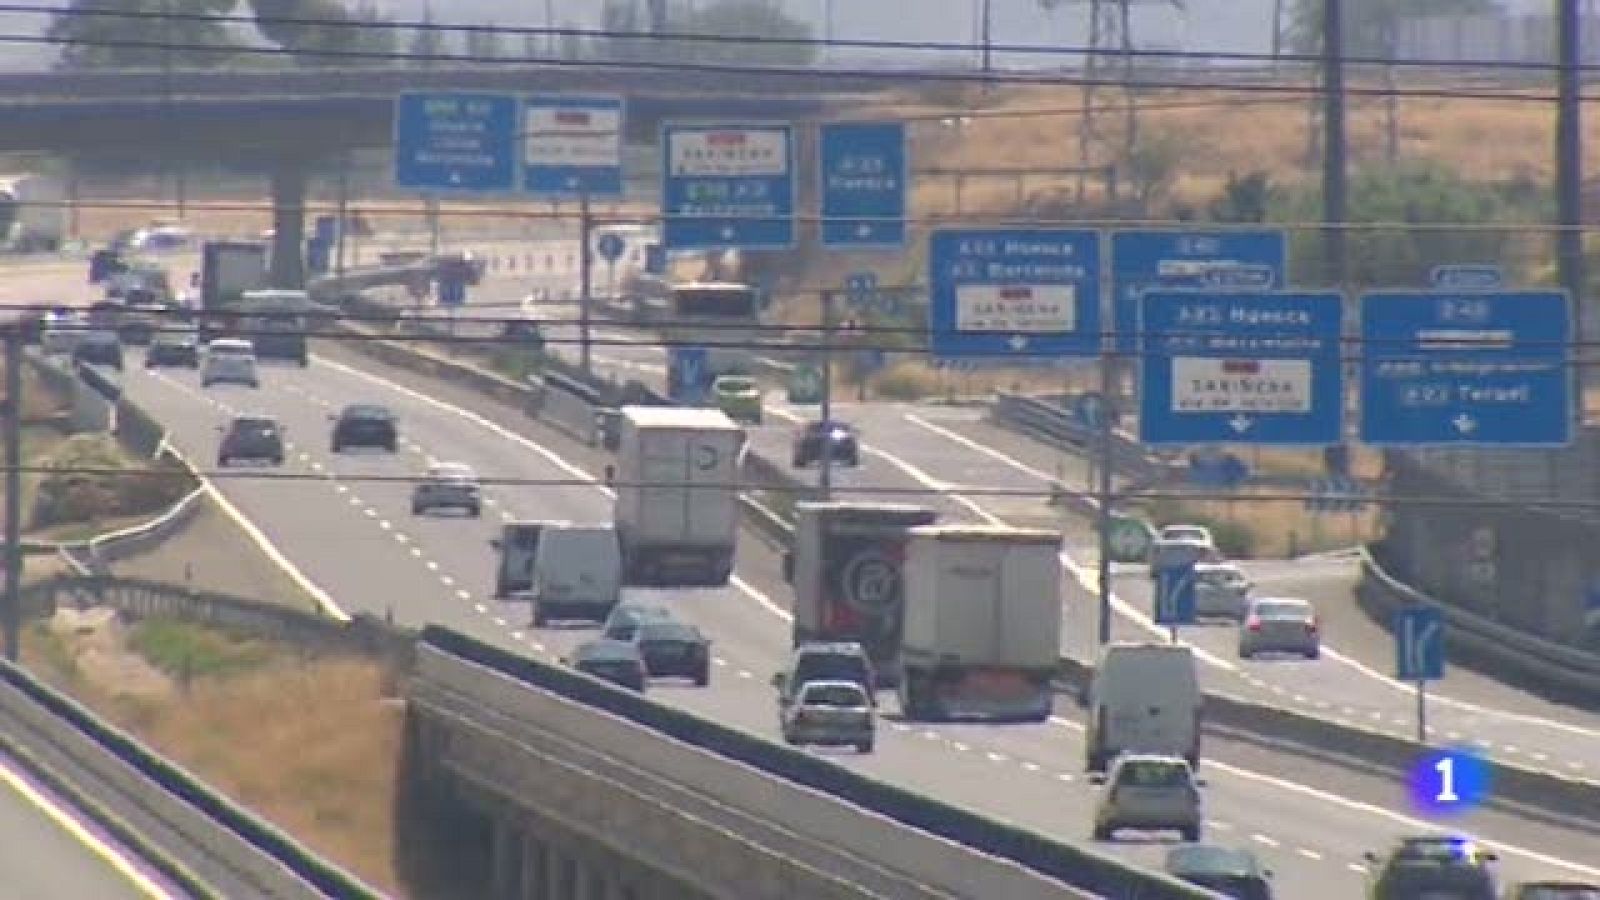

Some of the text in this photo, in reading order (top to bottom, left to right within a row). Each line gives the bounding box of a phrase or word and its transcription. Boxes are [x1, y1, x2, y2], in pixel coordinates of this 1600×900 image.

[1004, 239, 1073, 257] Huesca
[988, 262, 1086, 280] Barcelona
[1229, 305, 1309, 324] Huesca
[1458, 383, 1530, 402] Teruel
